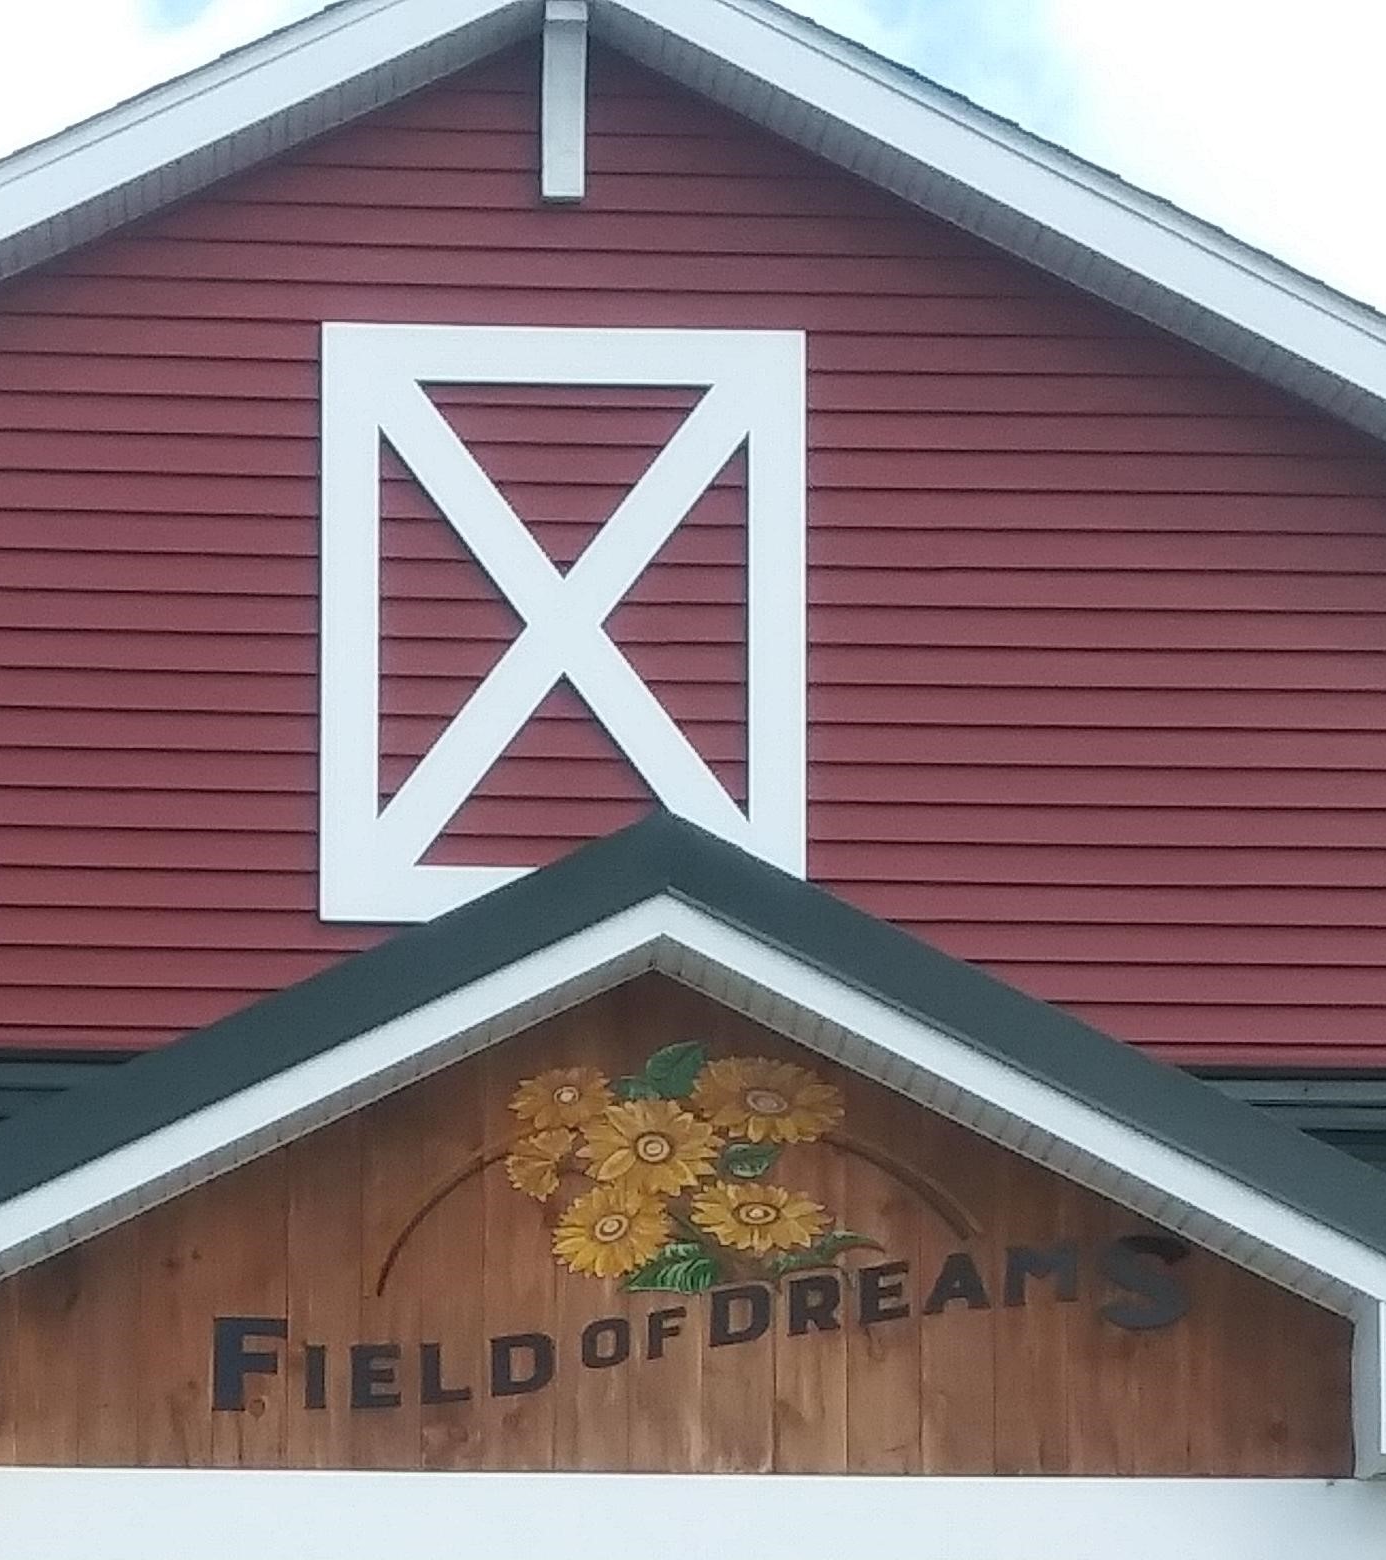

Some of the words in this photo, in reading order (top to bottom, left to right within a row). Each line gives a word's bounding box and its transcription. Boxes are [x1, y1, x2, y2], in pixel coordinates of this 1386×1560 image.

[212, 1315, 555, 1413] FIELD
[581, 1305, 687, 1369] OF
[709, 1234, 1191, 1348] DREAMS
